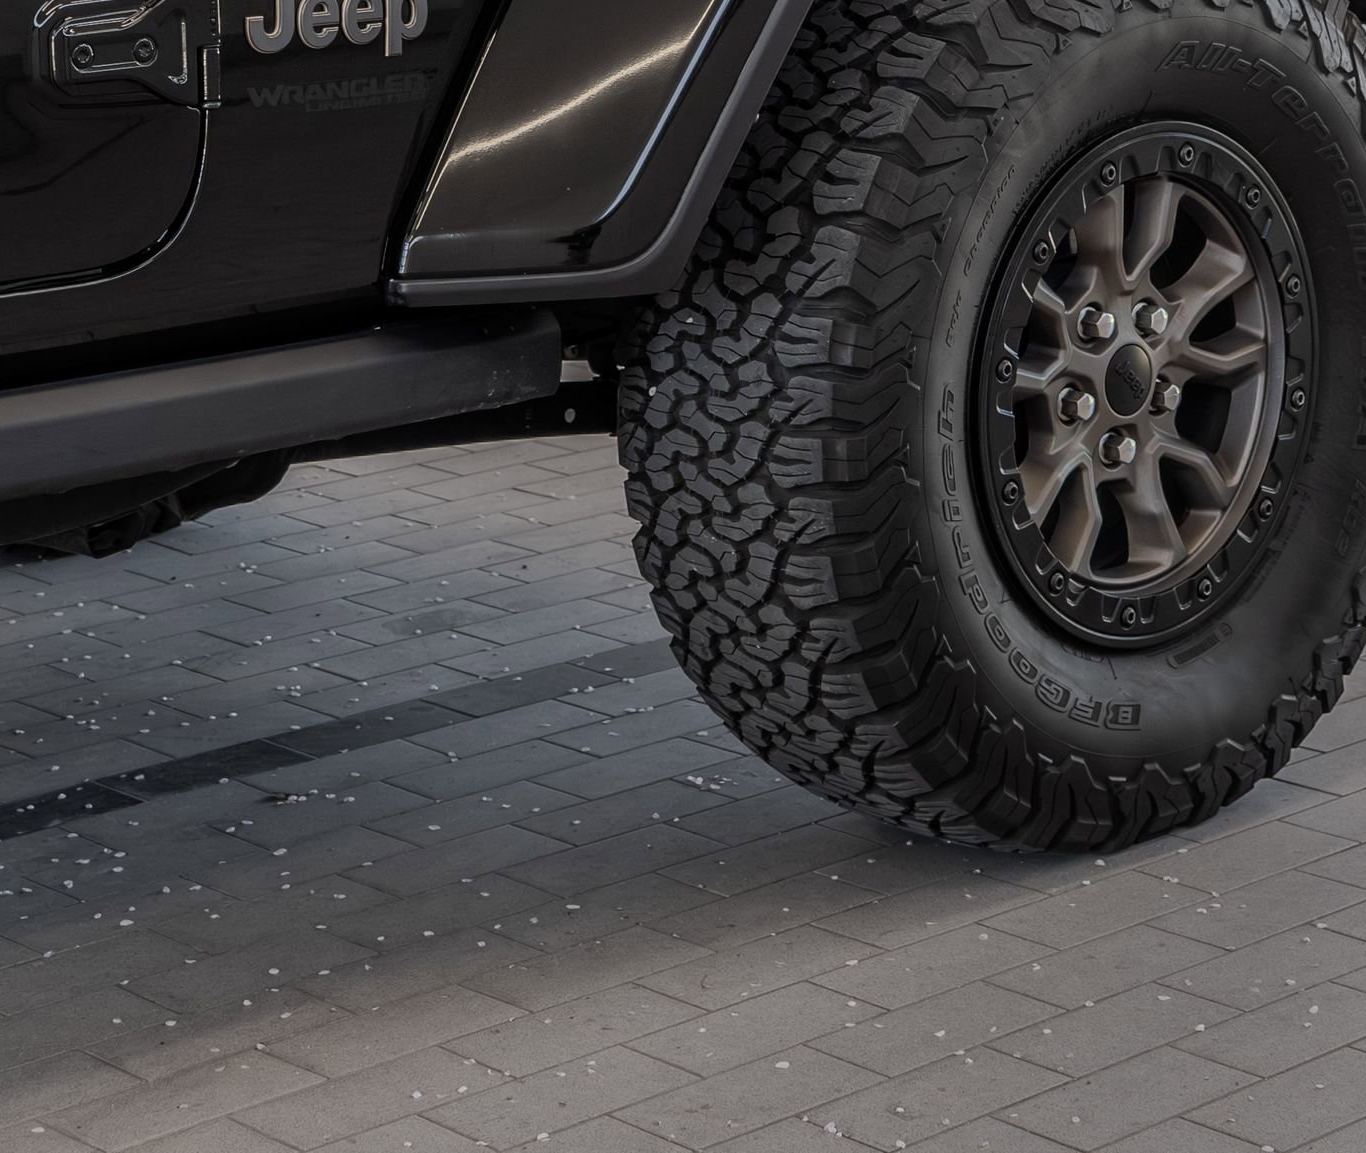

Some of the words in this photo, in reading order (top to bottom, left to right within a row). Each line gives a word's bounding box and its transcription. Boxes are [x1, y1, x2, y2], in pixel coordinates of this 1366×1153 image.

[246, 71, 426, 108] WRANGLER
[1114, 360, 1146, 401] Jeep
[936, 382, 1142, 732] BFGoodrich
